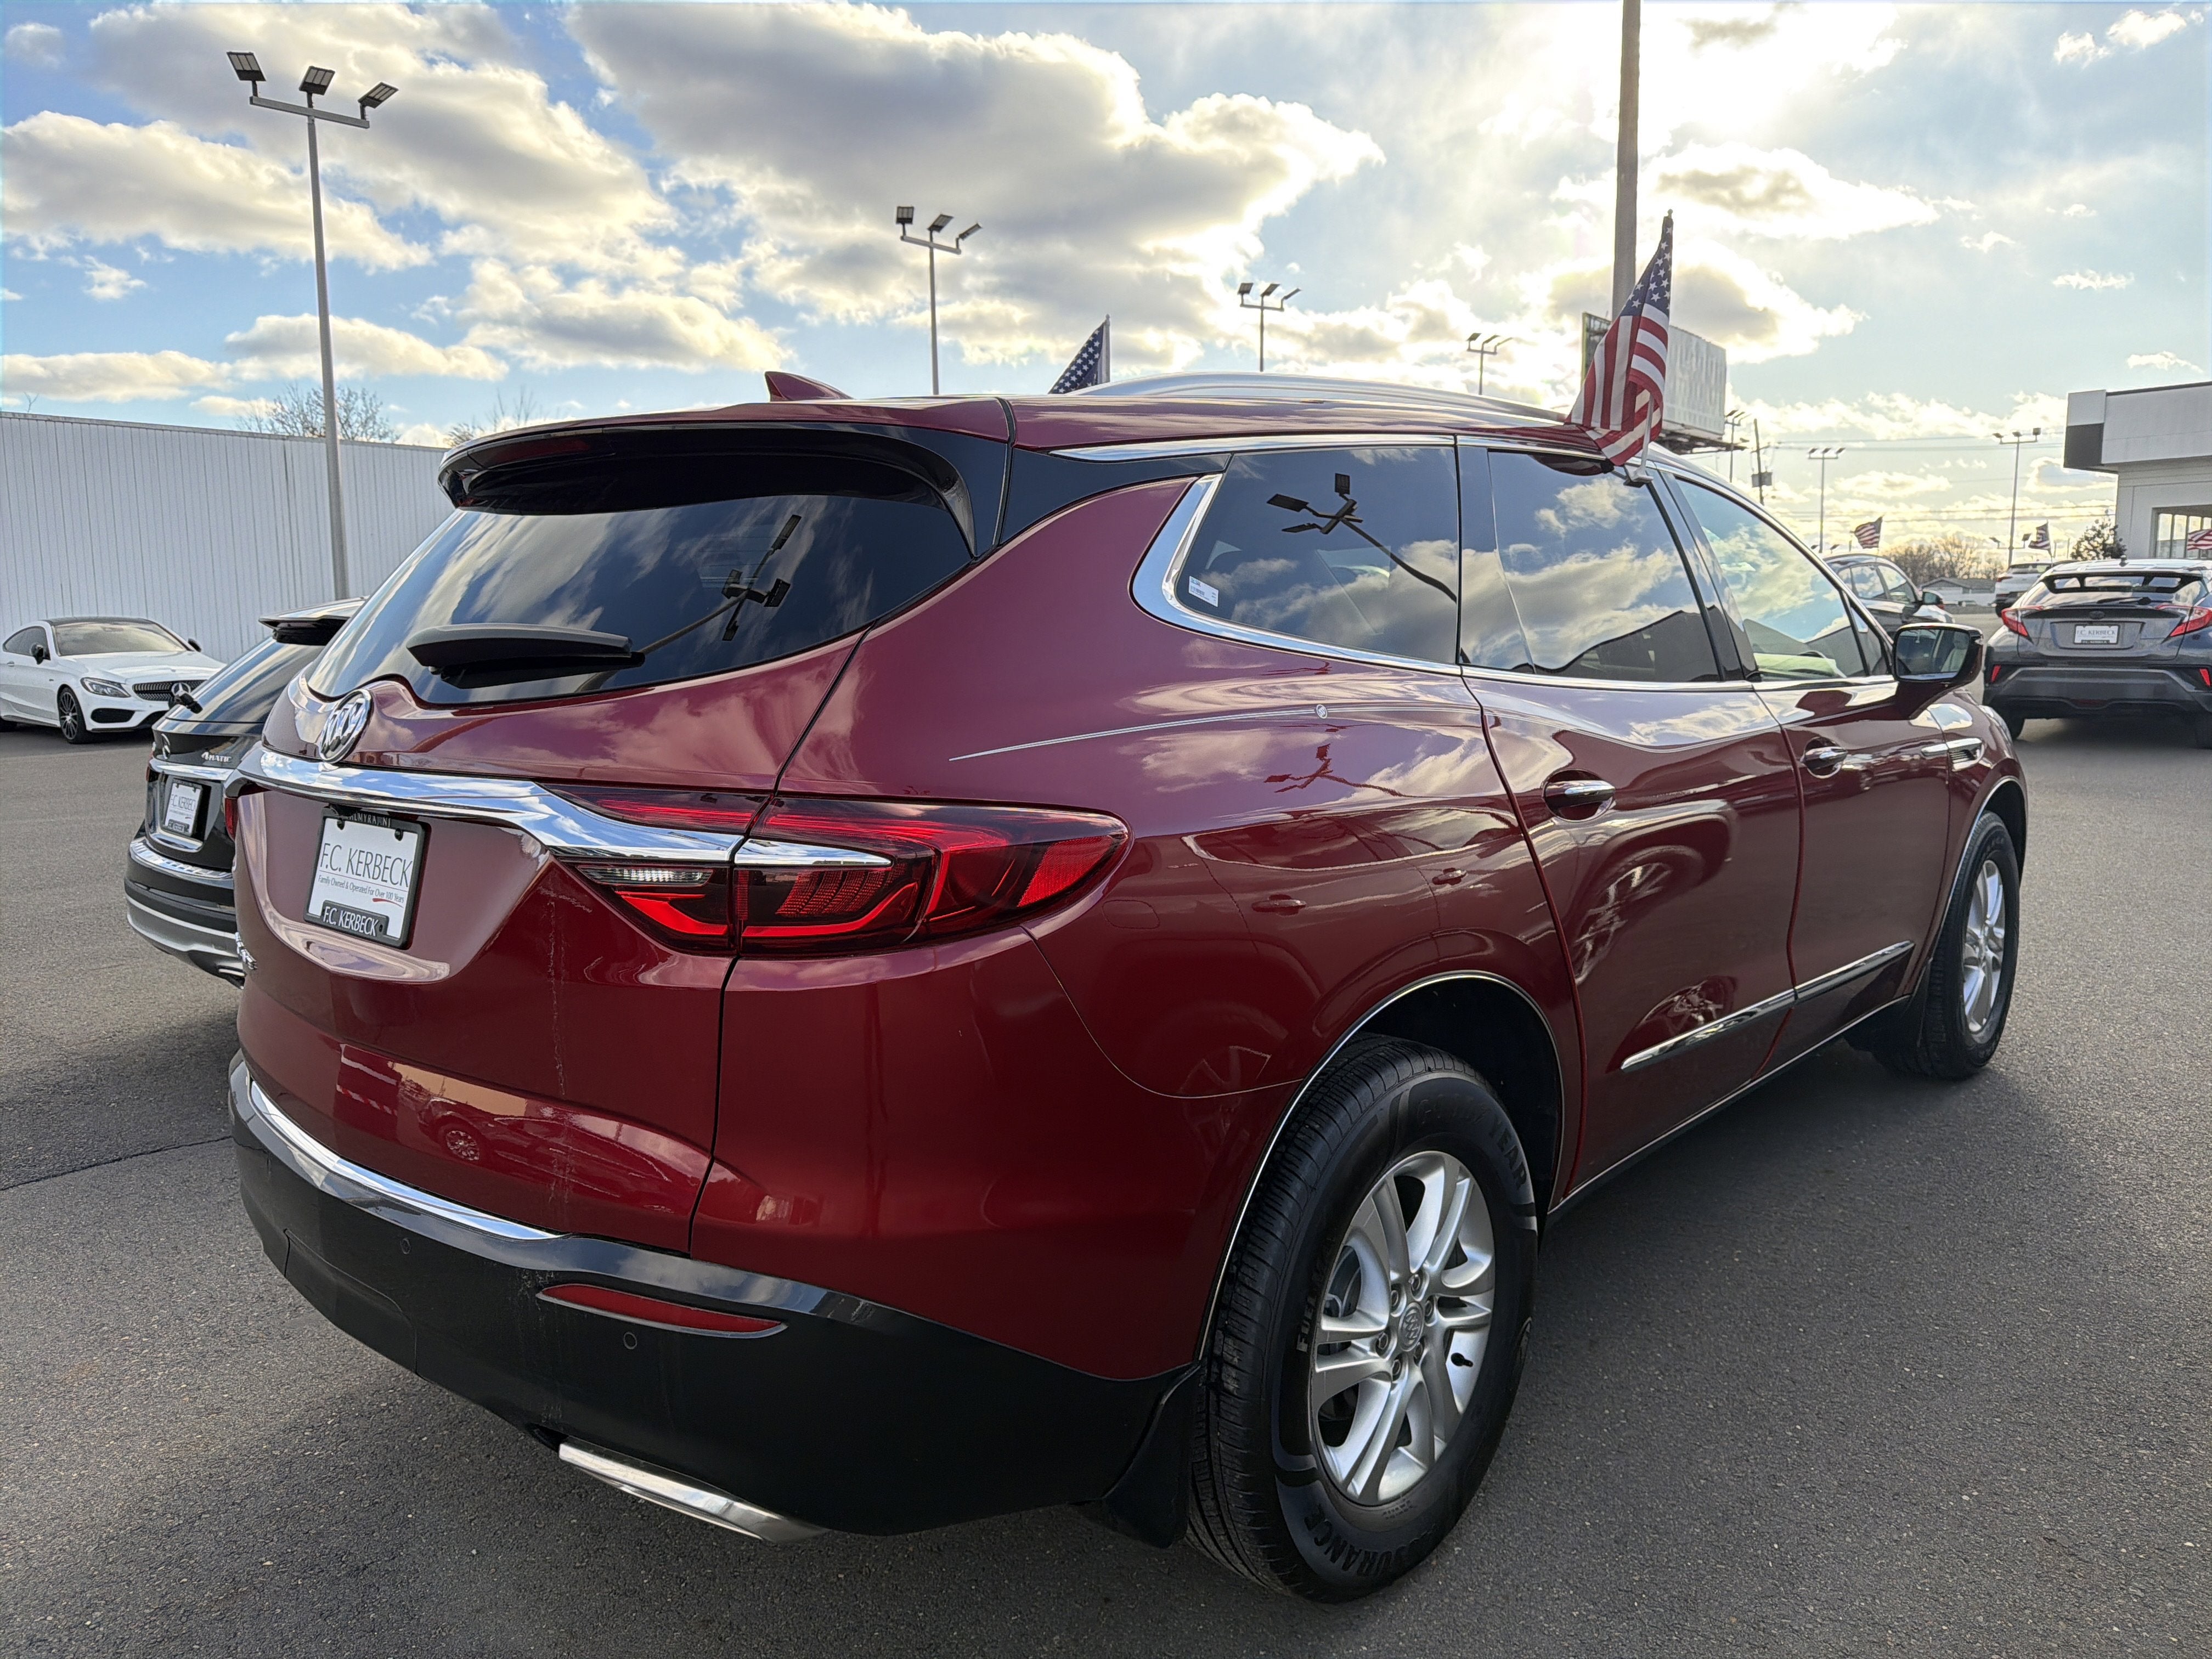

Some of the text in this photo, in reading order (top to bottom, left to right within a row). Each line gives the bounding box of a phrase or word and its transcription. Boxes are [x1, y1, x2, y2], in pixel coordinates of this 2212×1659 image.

[320, 843, 413, 888] F.C. KERBECK
[318, 874, 331, 885] Family
[331, 878, 346, 888] Owned
[345, 882, 349, 890] &
[349, 882, 368, 894] Operated
[375, 888, 385, 898] Over
[385, 891, 394, 900] 100
[394, 893, 404, 904] Years
[323, 906, 379, 937] F.C. KERBECK
